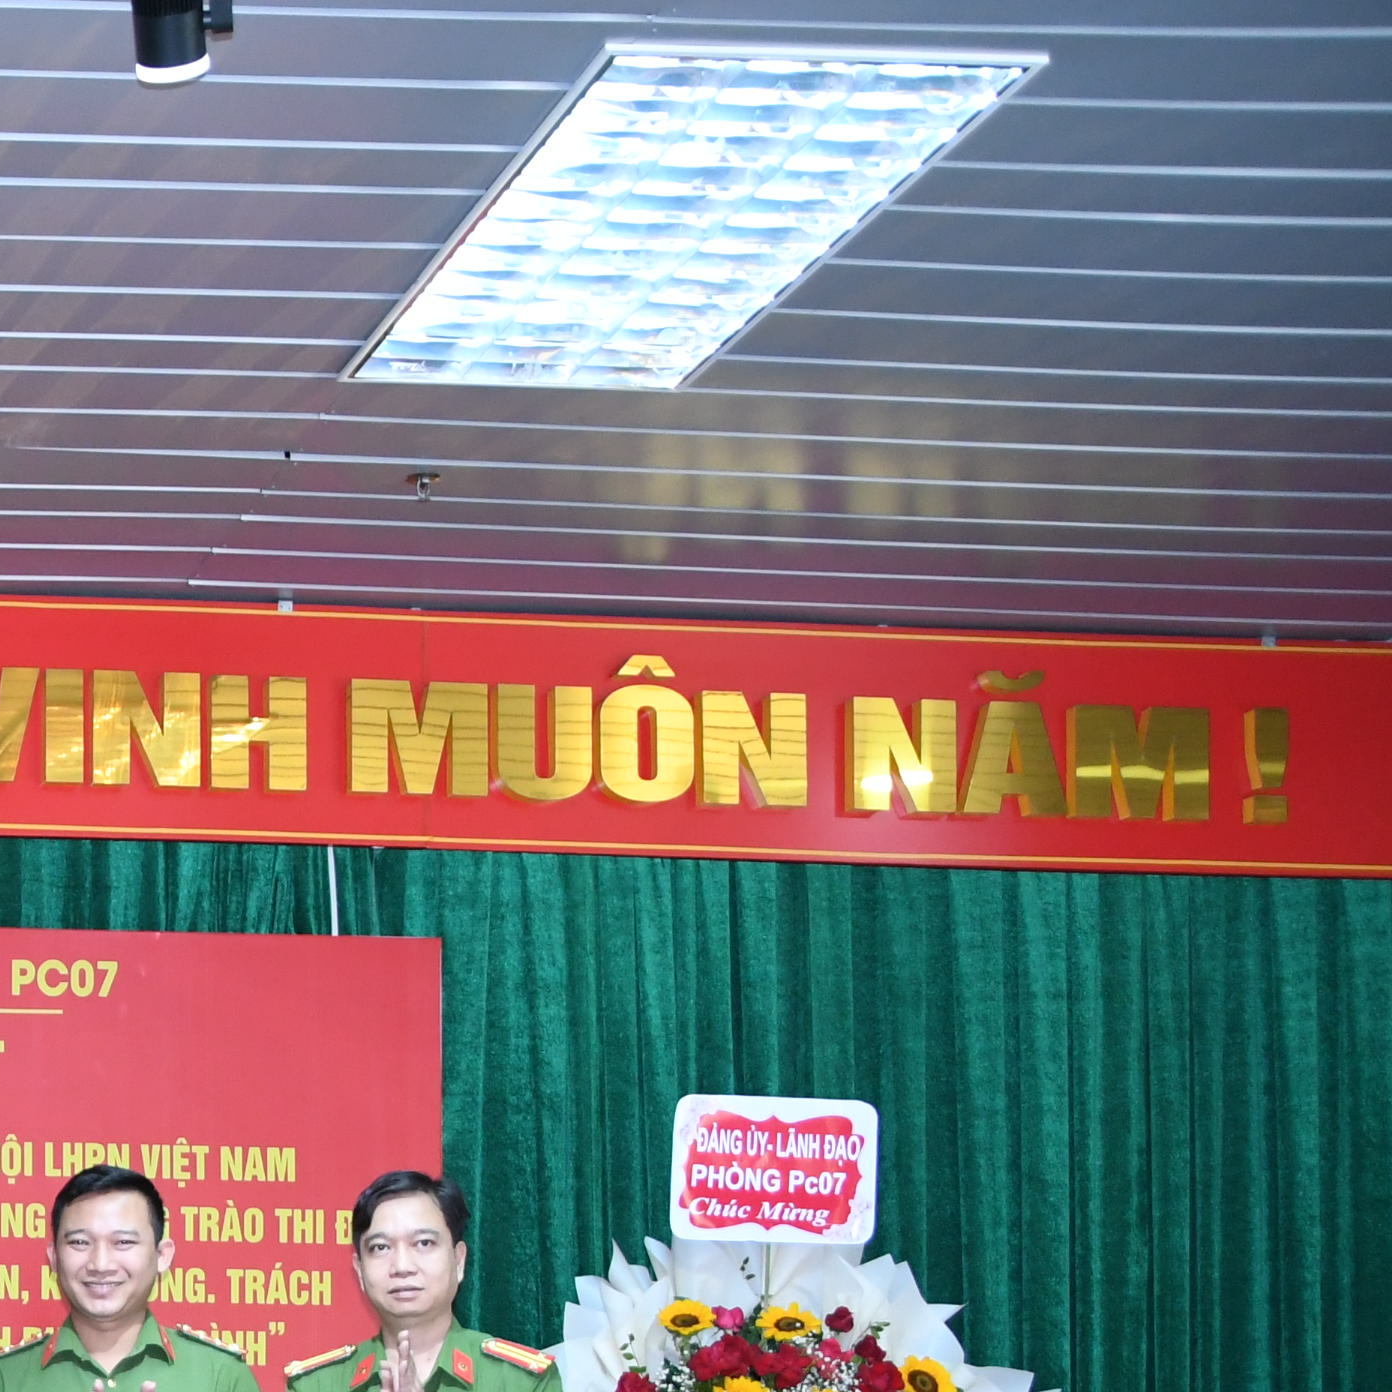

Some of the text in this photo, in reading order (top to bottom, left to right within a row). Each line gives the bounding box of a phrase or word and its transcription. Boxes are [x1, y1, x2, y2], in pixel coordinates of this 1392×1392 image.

[348, 654, 809, 807] MUÔN
[848, 670, 1211, 821] NĂM
[12, 960, 118, 998] PC07
[141, 1137, 209, 1188] VIỆT
[220, 1146, 296, 1182] NAM
[697, 1122, 742, 1155] ĐẢNG
[776, 1128, 820, 1160] LÃNH
[824, 1134, 861, 1166] ĐẠO
[691, 1162, 781, 1192] PHÒNG
[180, 1200, 264, 1243] TRÀO
[274, 1208, 324, 1244] THI
[689, 1197, 830, 1227] Chúc Mừng
[226, 1262, 332, 1306] TRÁCH
